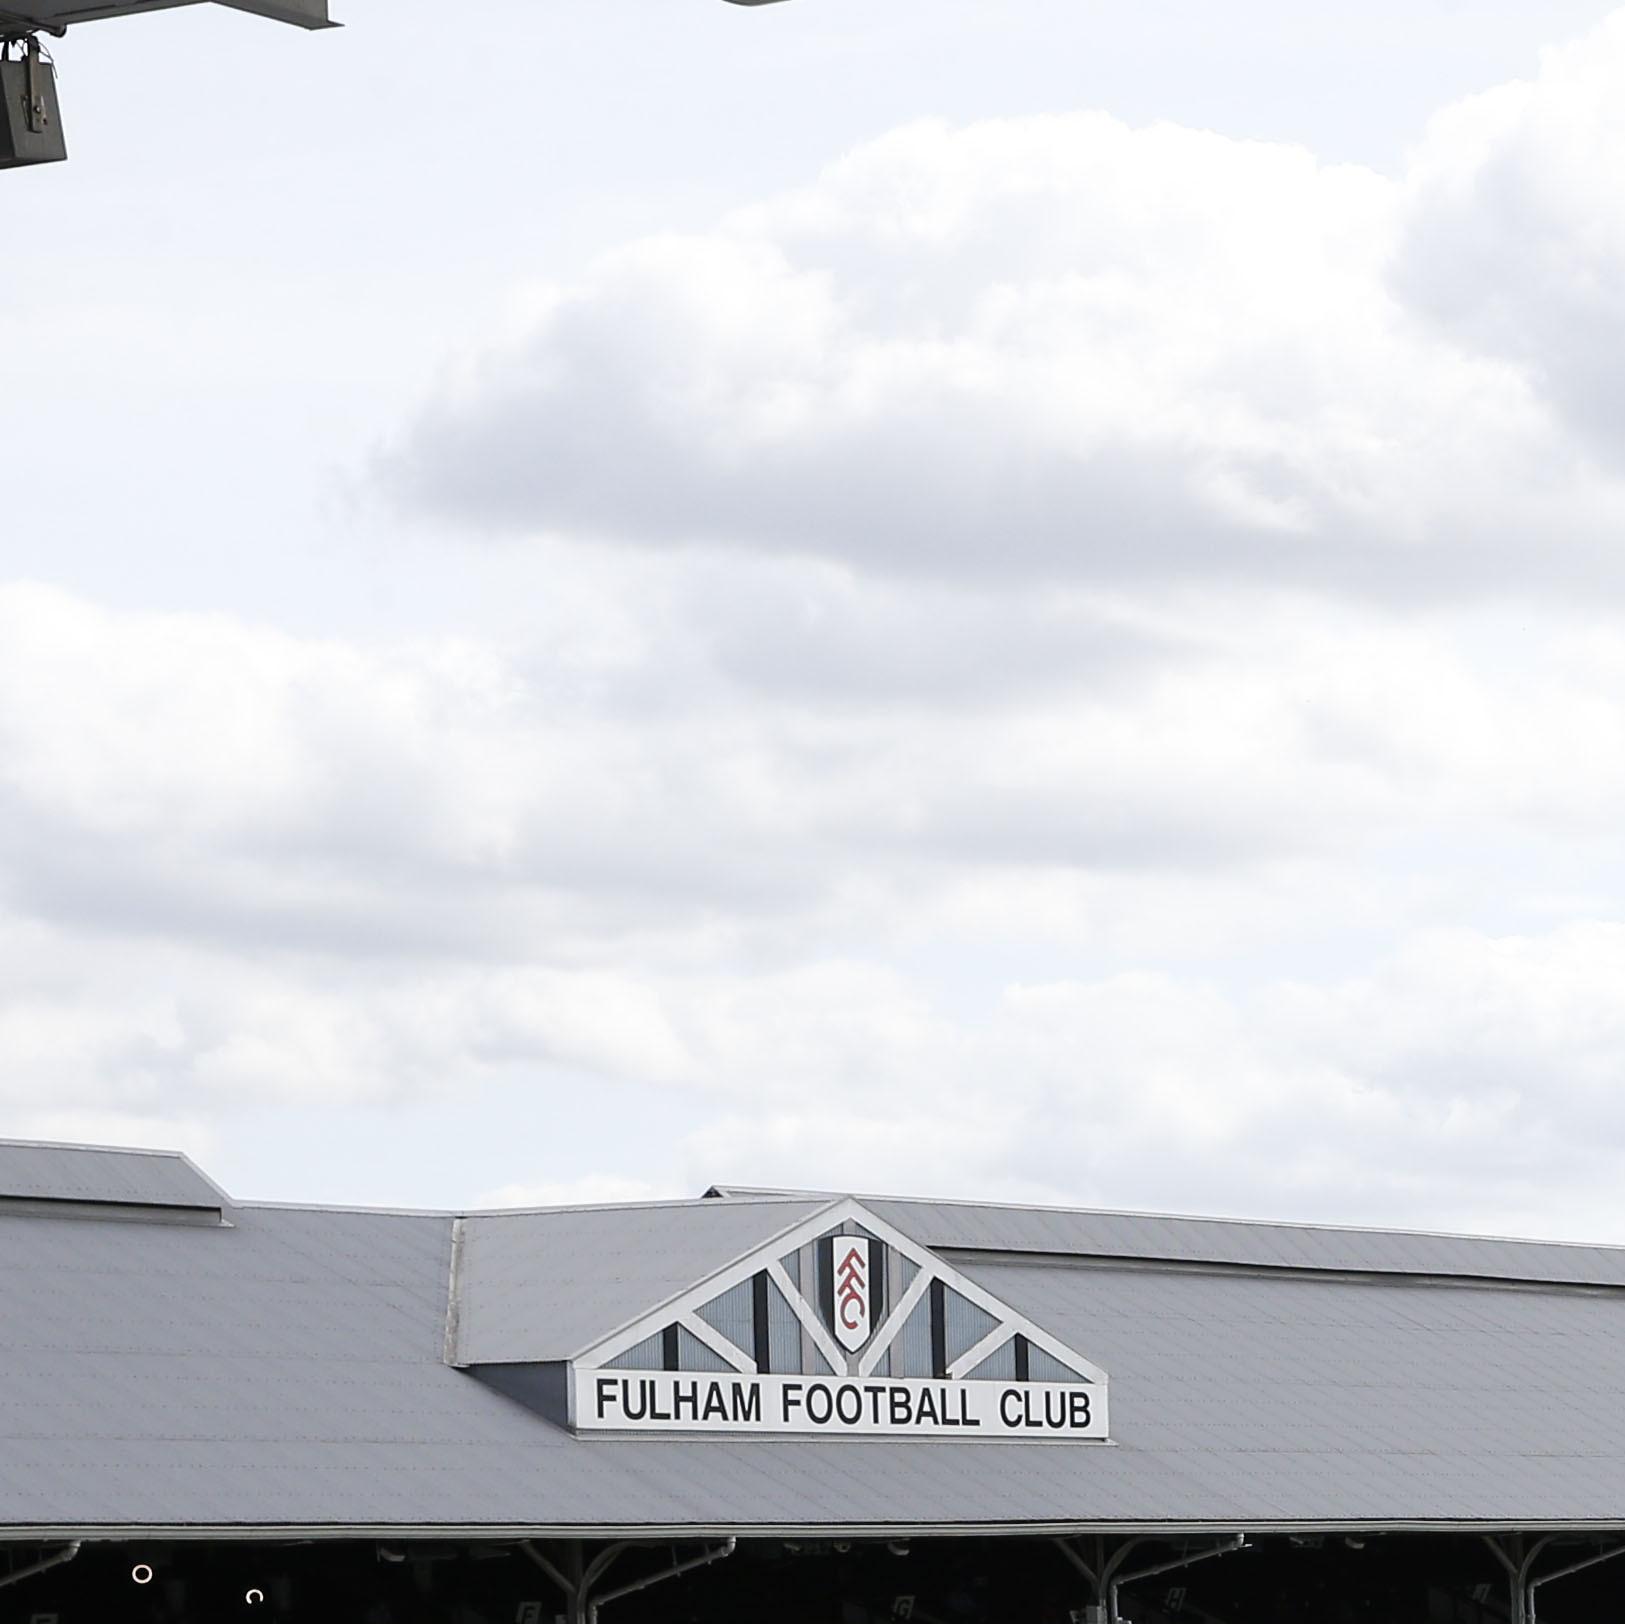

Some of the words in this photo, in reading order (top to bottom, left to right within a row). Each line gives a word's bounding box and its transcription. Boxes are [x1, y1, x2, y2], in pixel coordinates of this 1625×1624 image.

[595, 1379, 762, 1423] FULHAM
[781, 1383, 981, 1427] FOOTBALL
[999, 1388, 1093, 1430] CLUB
